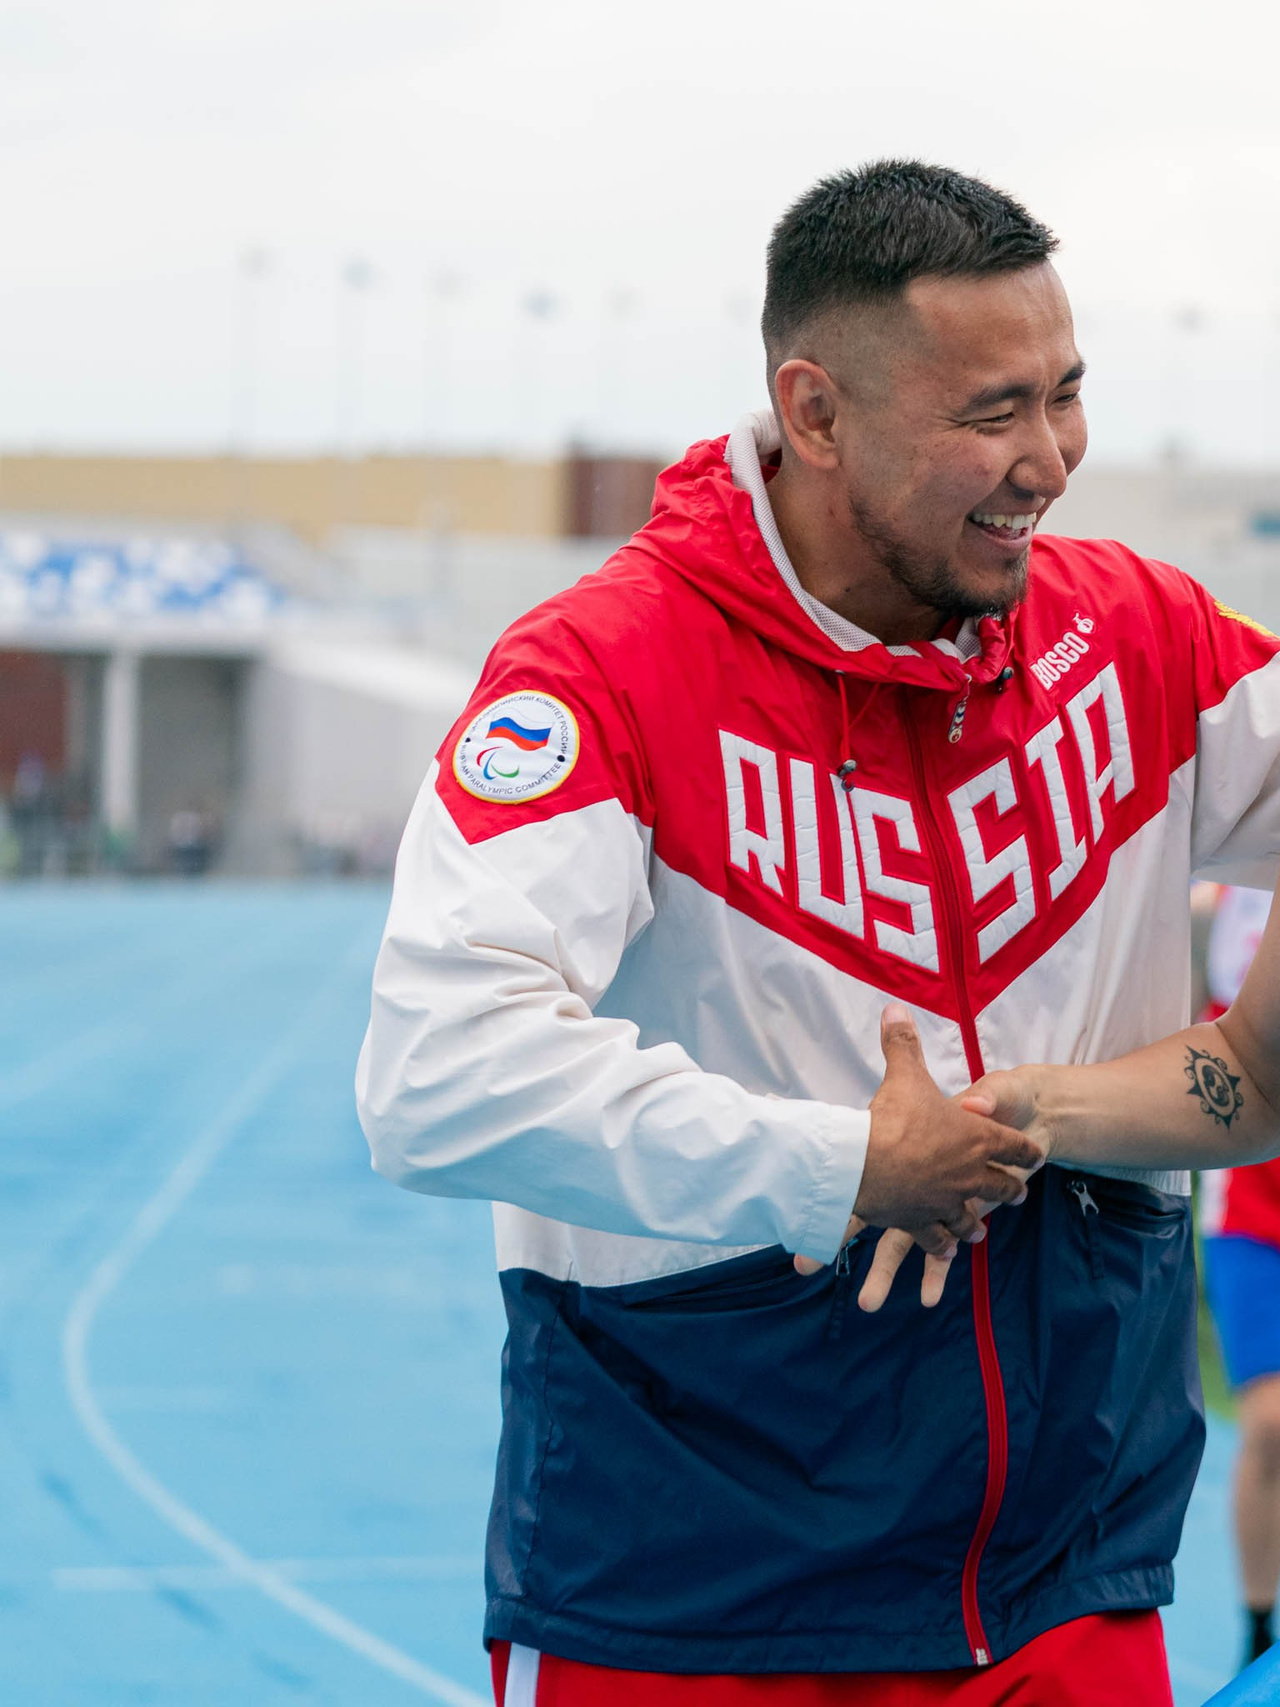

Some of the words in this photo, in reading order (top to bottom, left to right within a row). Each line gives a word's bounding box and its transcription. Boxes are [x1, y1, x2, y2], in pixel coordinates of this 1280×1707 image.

[1029, 631, 1090, 691] BOSCO
[535, 697, 564, 720] КОМИТЕТ
[468, 773, 513, 795] PARALYMPIC
[515, 762, 561, 794] COMMITTEE
[718, 661, 1136, 974] RUSSIA
